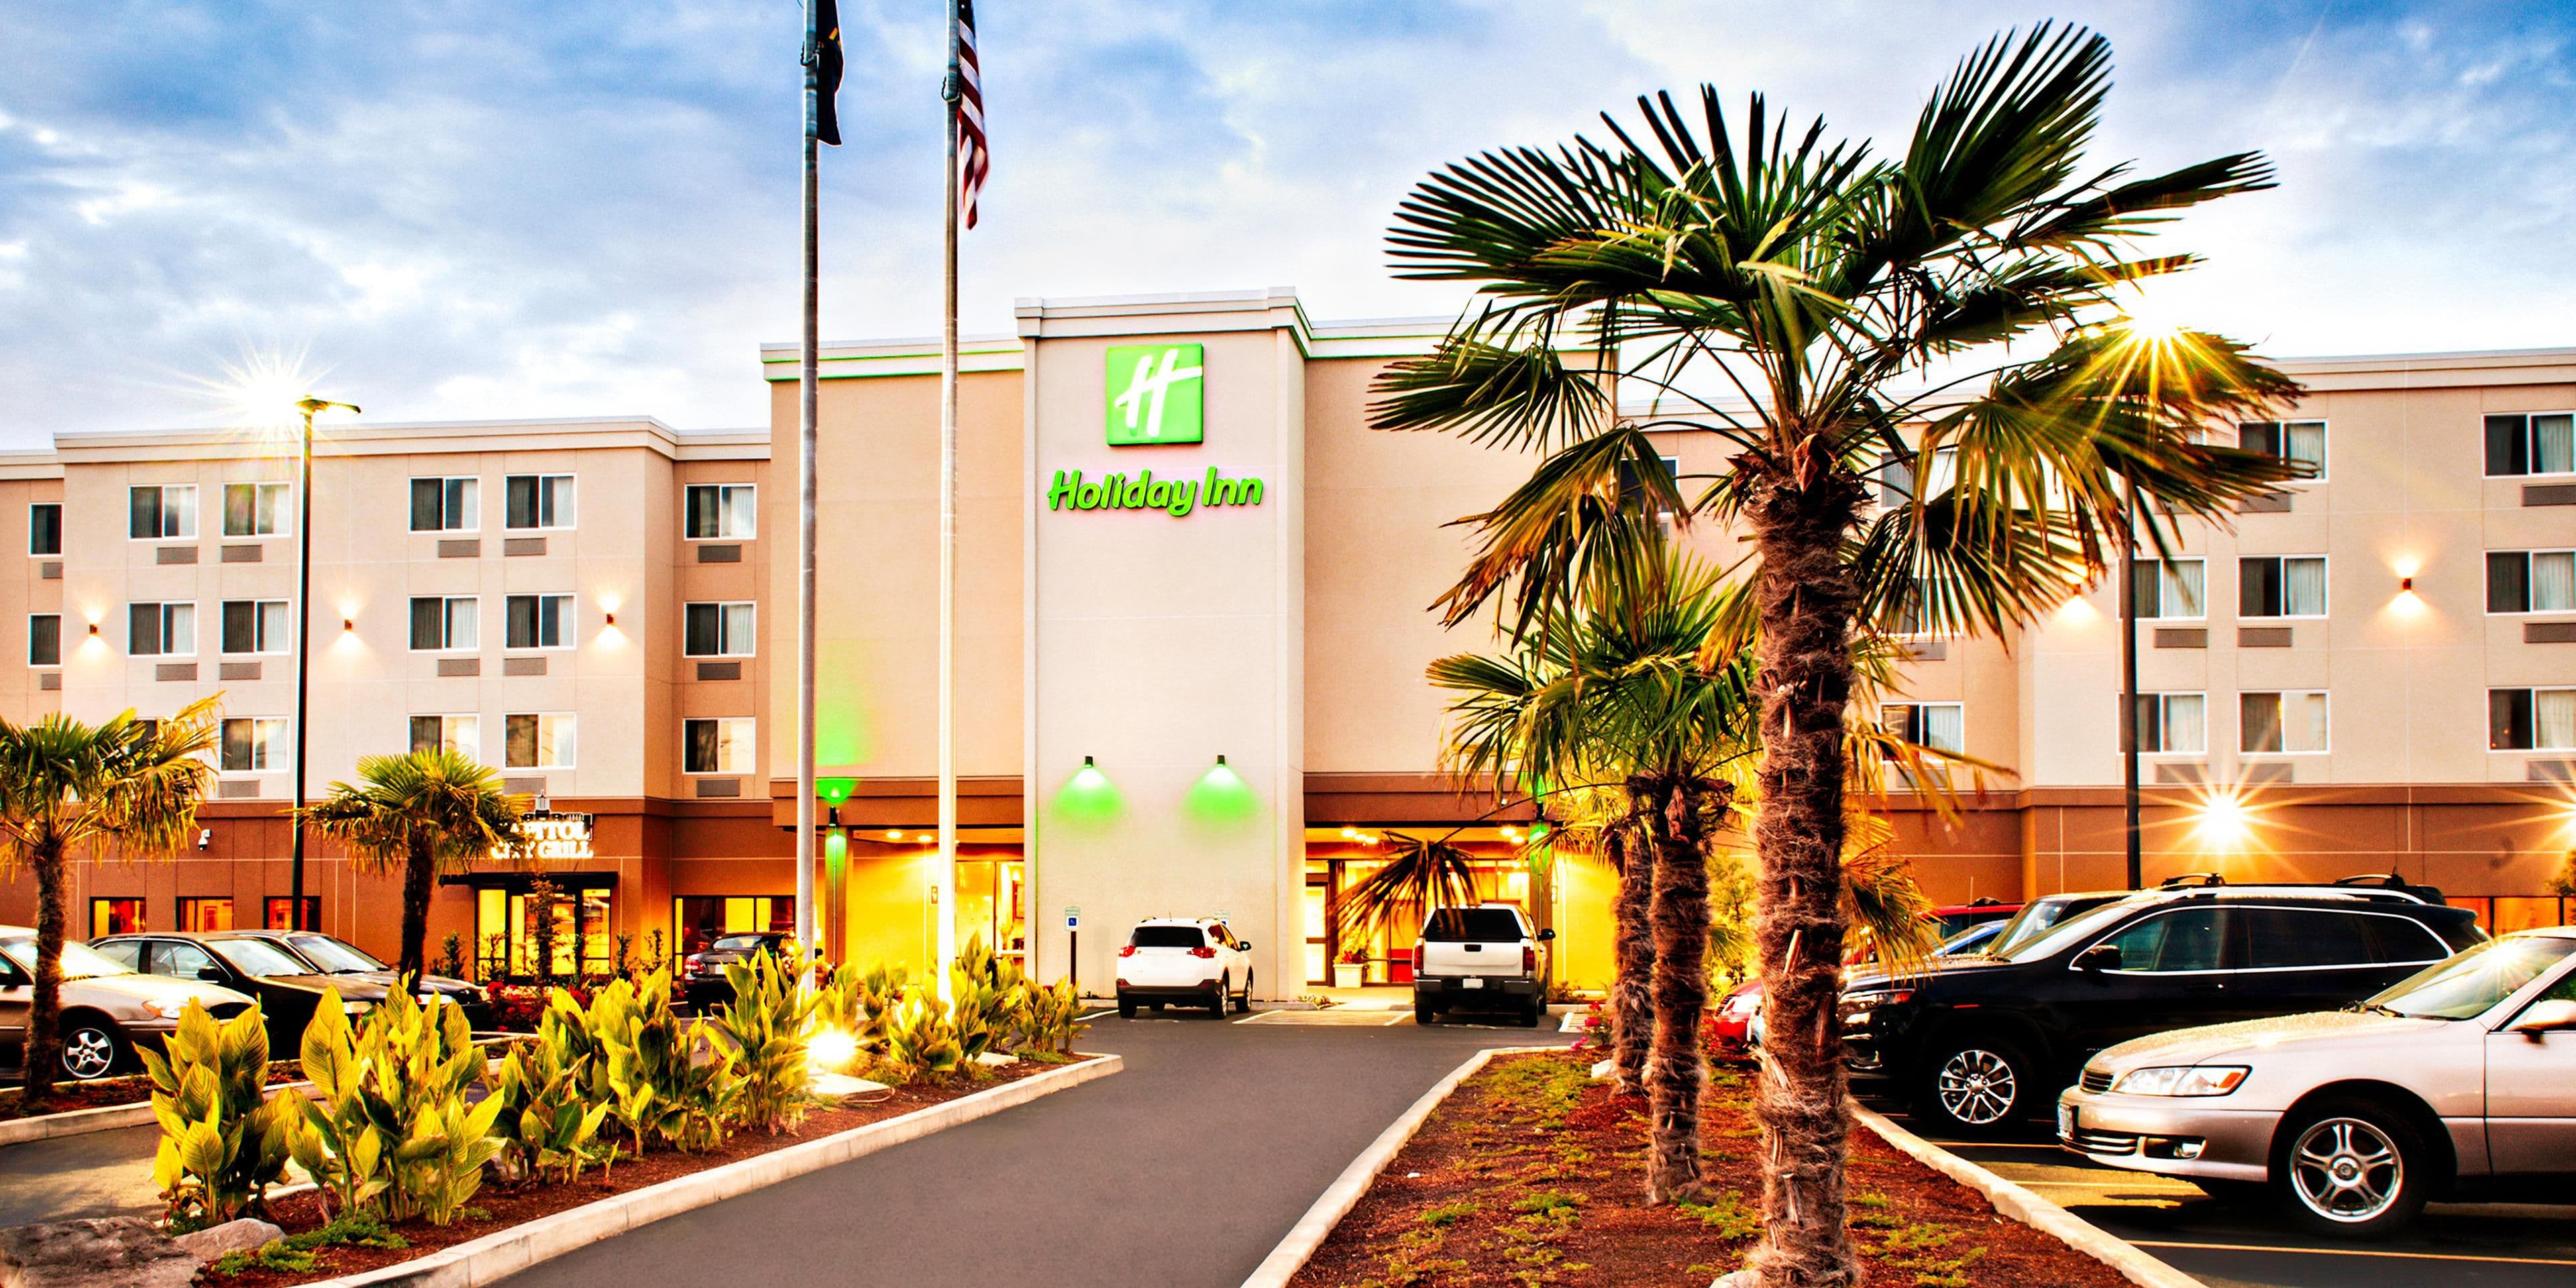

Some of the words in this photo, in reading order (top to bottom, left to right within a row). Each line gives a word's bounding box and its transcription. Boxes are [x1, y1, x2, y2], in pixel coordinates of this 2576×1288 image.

[1046, 469, 1197, 517] Holiday
[1201, 466, 1264, 506] Inn
[498, 820, 590, 840] APITOL
[537, 841, 594, 859] GRILL
